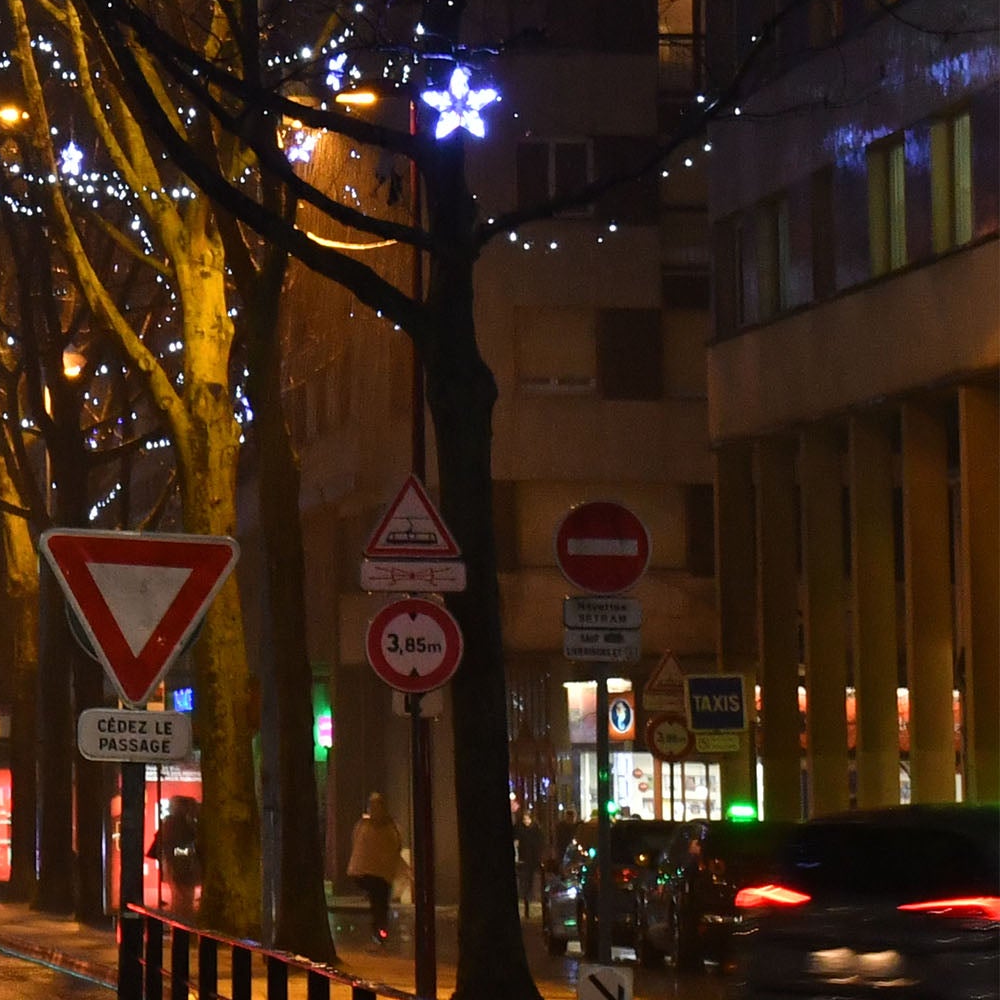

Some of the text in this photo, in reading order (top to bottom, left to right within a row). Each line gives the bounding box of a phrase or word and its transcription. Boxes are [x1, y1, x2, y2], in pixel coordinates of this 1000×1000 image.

[386, 633, 442, 656] 3,85m
[692, 694, 741, 713] TAXIS
[97, 717, 173, 736] CÉDEZ LE
[98, 738, 171, 754] PASSAGE
